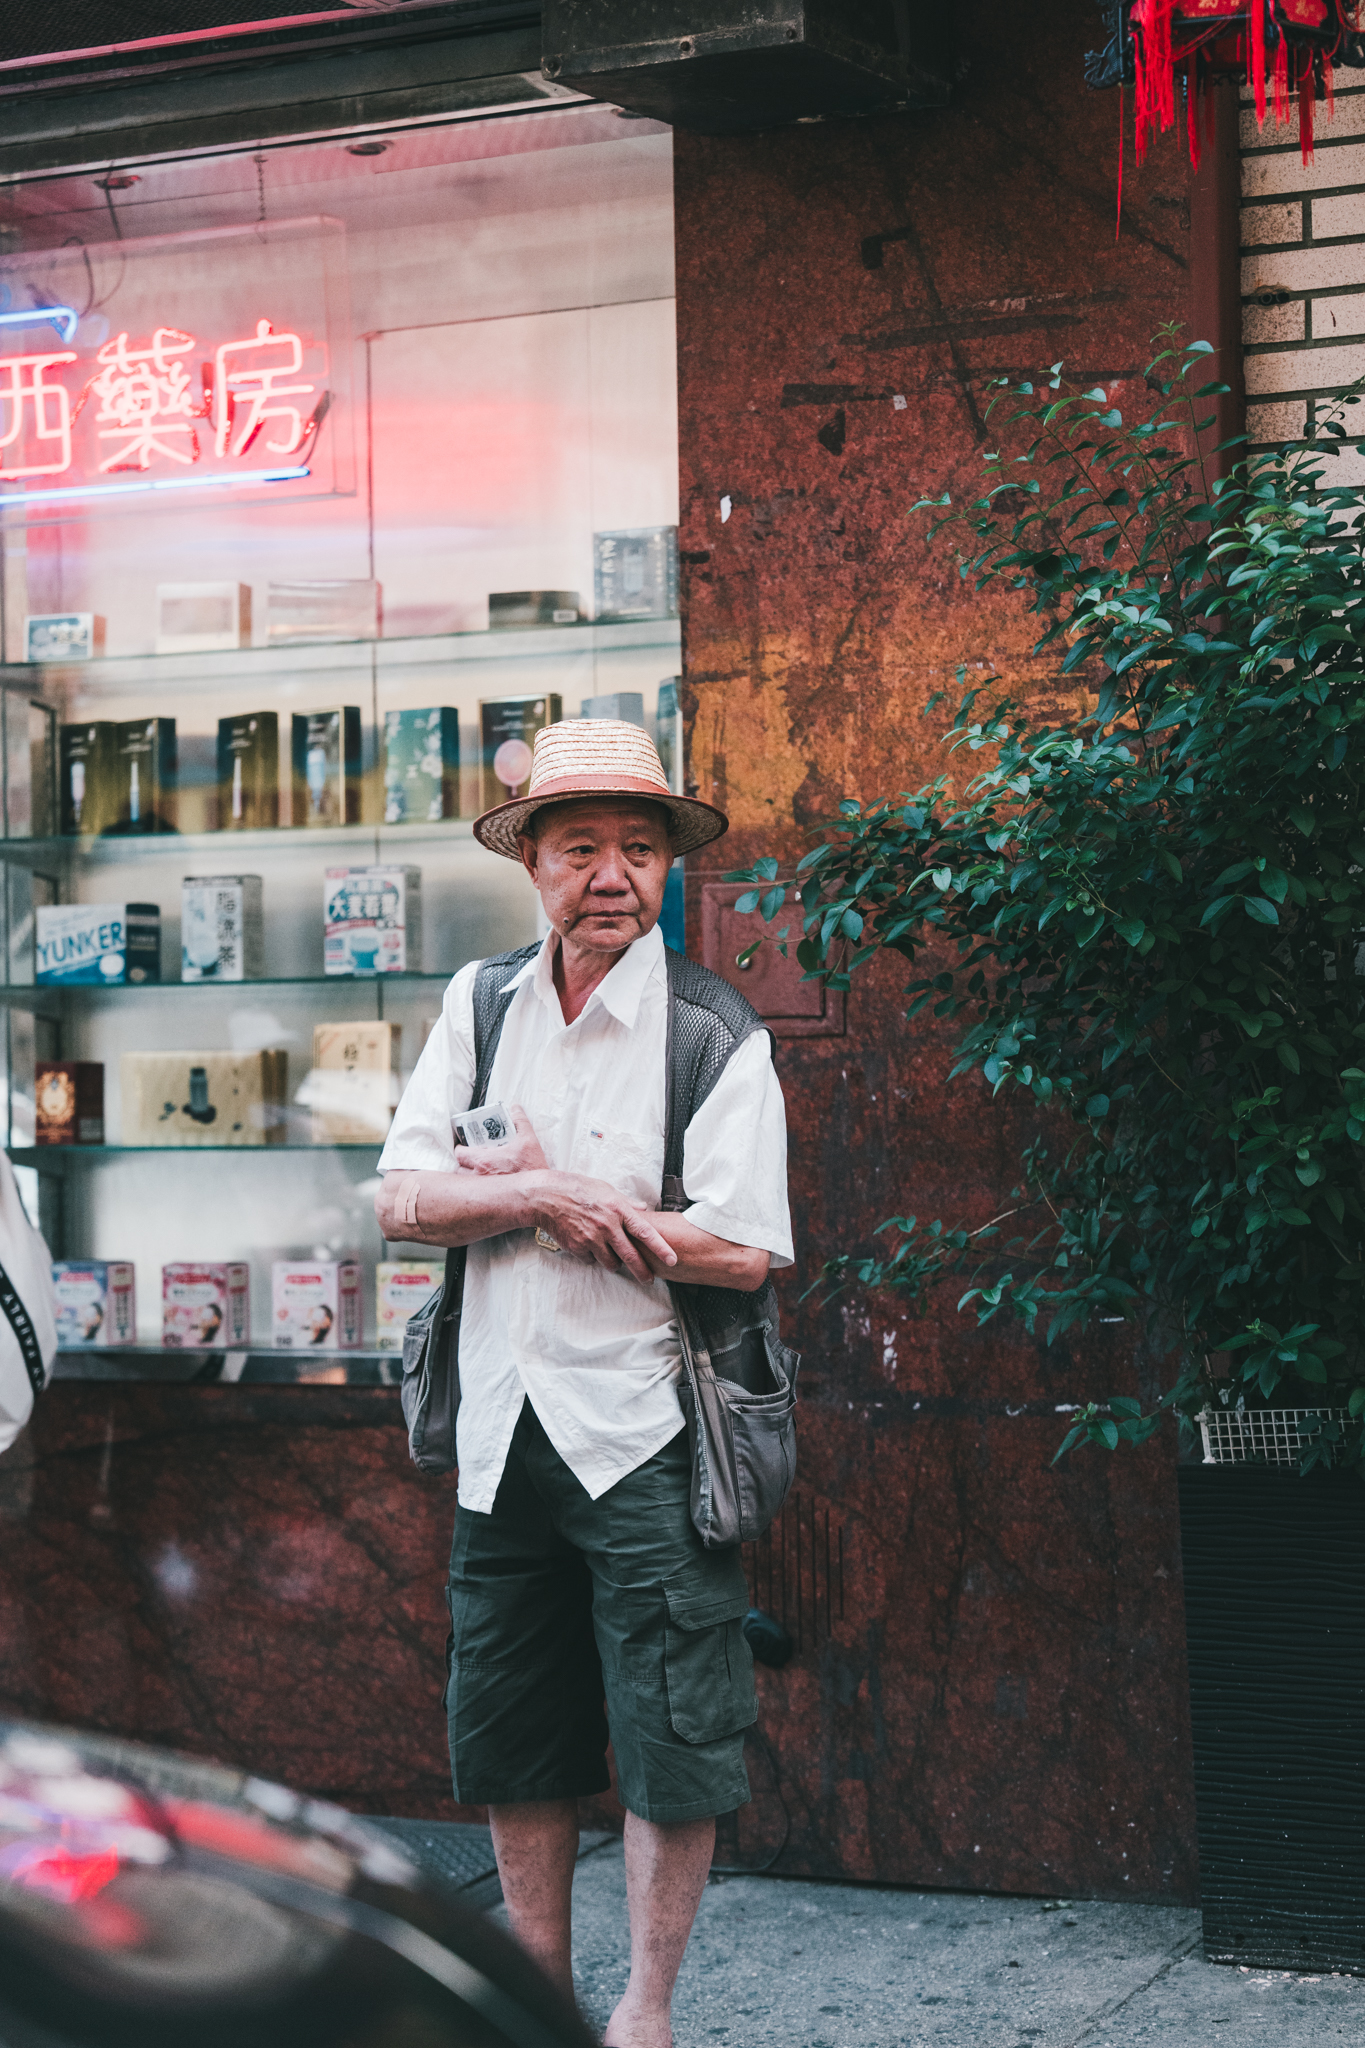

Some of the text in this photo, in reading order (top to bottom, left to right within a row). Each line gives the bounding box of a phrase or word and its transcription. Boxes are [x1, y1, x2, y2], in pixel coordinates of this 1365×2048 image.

[0, 318, 314, 479] 西藥房
[38, 922, 126, 966] YUNKER
